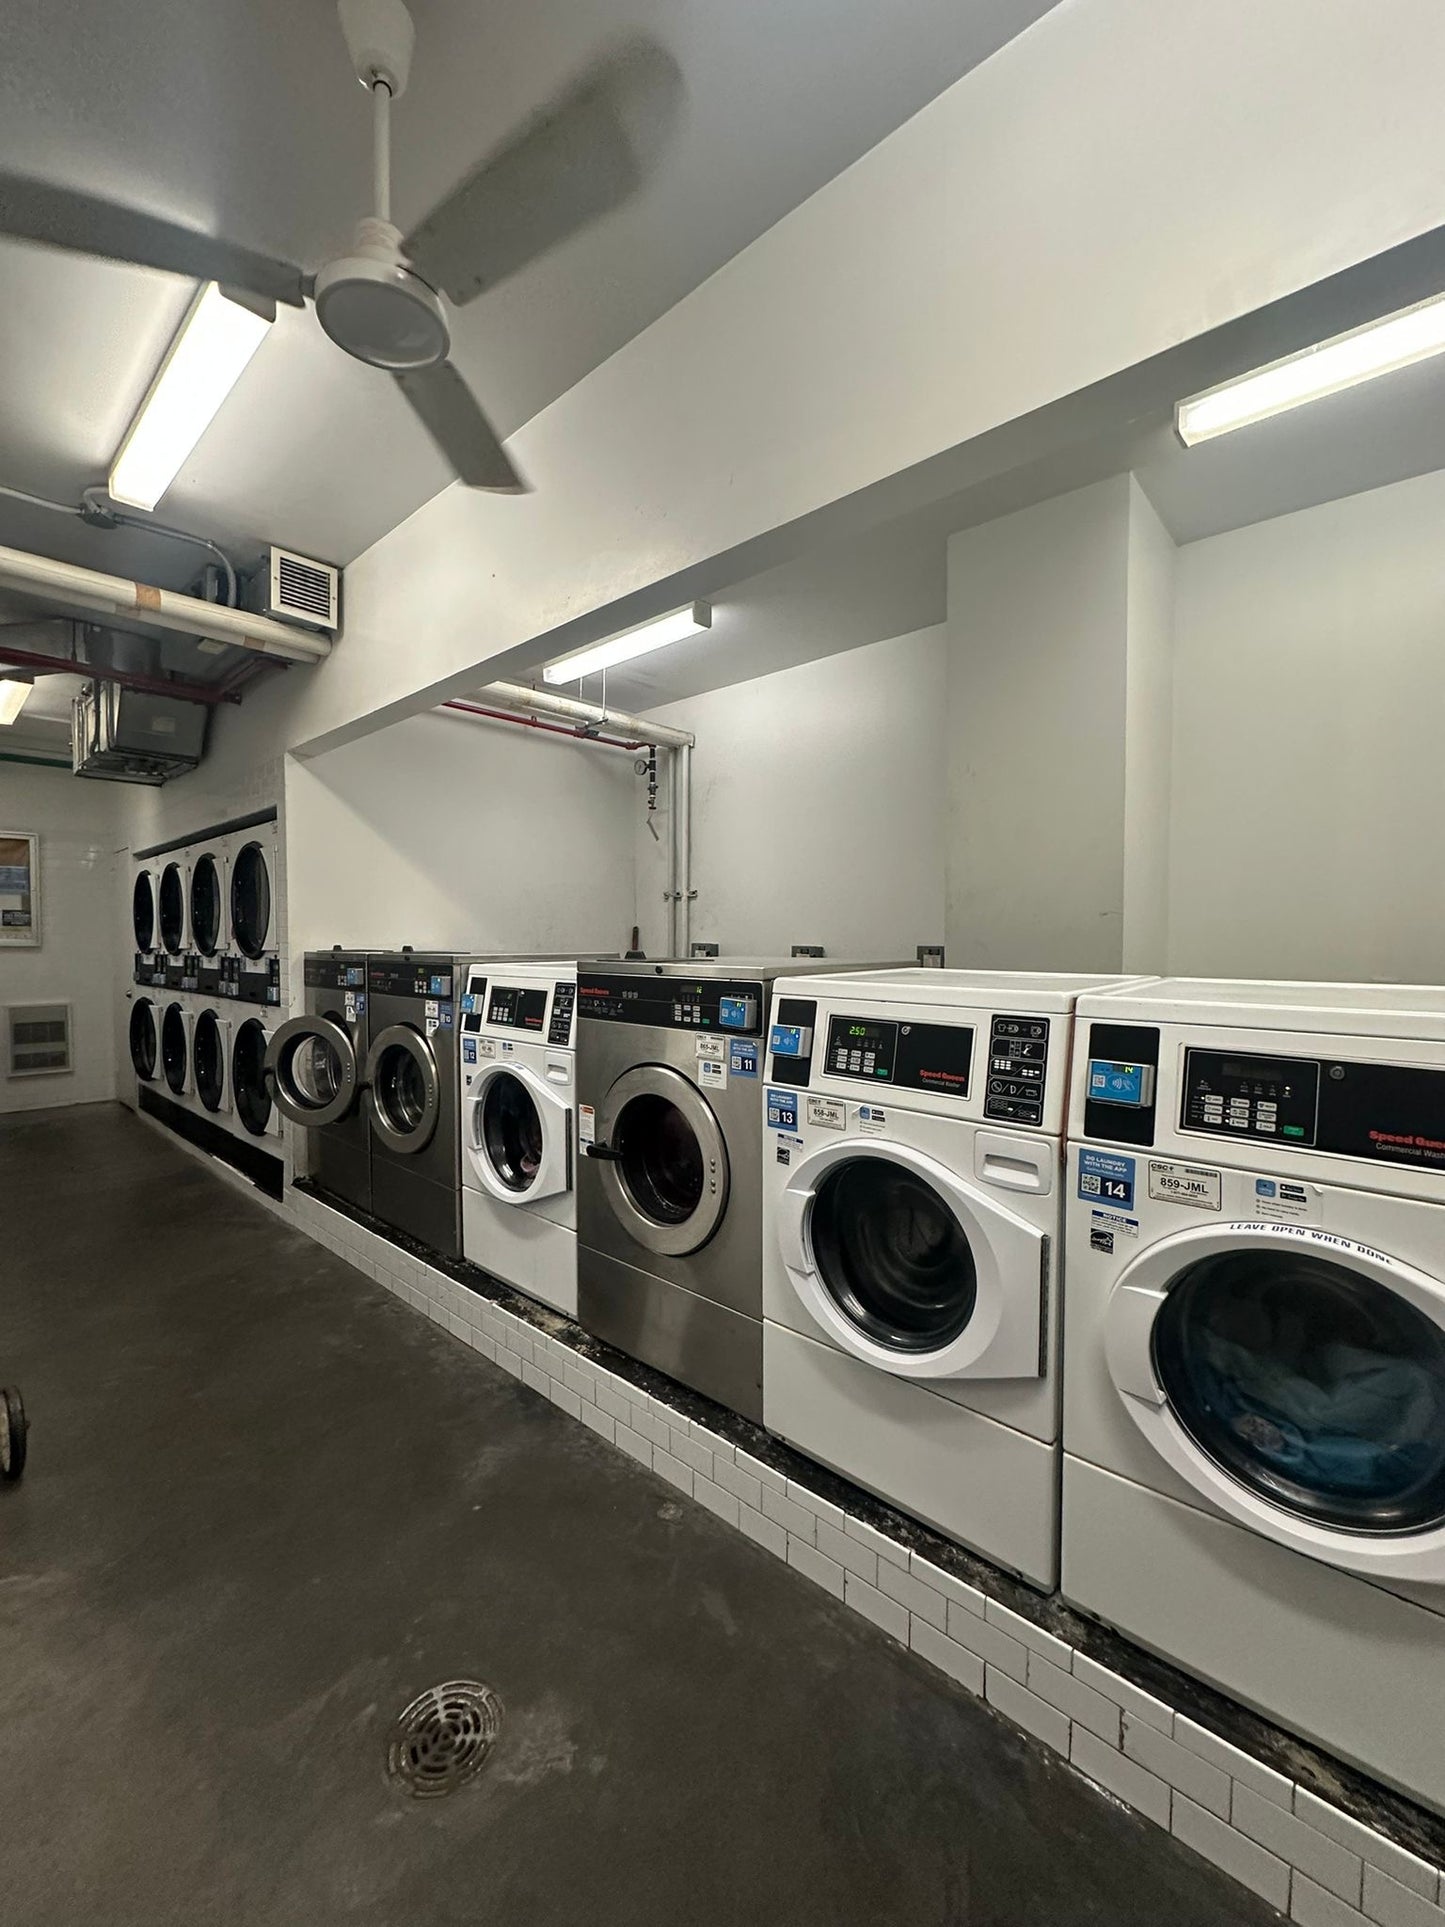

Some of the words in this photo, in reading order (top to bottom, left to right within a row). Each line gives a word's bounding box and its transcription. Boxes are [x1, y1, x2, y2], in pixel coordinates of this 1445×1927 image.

[744, 1059, 753, 1070] 11
[920, 1069, 942, 1078] Speed
[941, 1070, 965, 1082] Queen
[781, 1111, 793, 1124] 13
[1369, 1130, 1413, 1144] Speed
[1415, 1136, 1445, 1149] Quee
[1376, 1142, 1422, 1156] Commercial
[1084, 1160, 1100, 1168] WITH
[1101, 1163, 1113, 1171] THE
[1085, 1154, 1095, 1162] DO
[1096, 1156, 1126, 1167] LAUNDRY
[1151, 1163, 1168, 1171] CSC
[1105, 1181, 1126, 1198] 14
[1160, 1177, 1209, 1194] 859-JML
[1229, 1223, 1267, 1231] LEAVE
[1271, 1225, 1306, 1236] OPEN
[1311, 1231, 1351, 1249] WHEN
